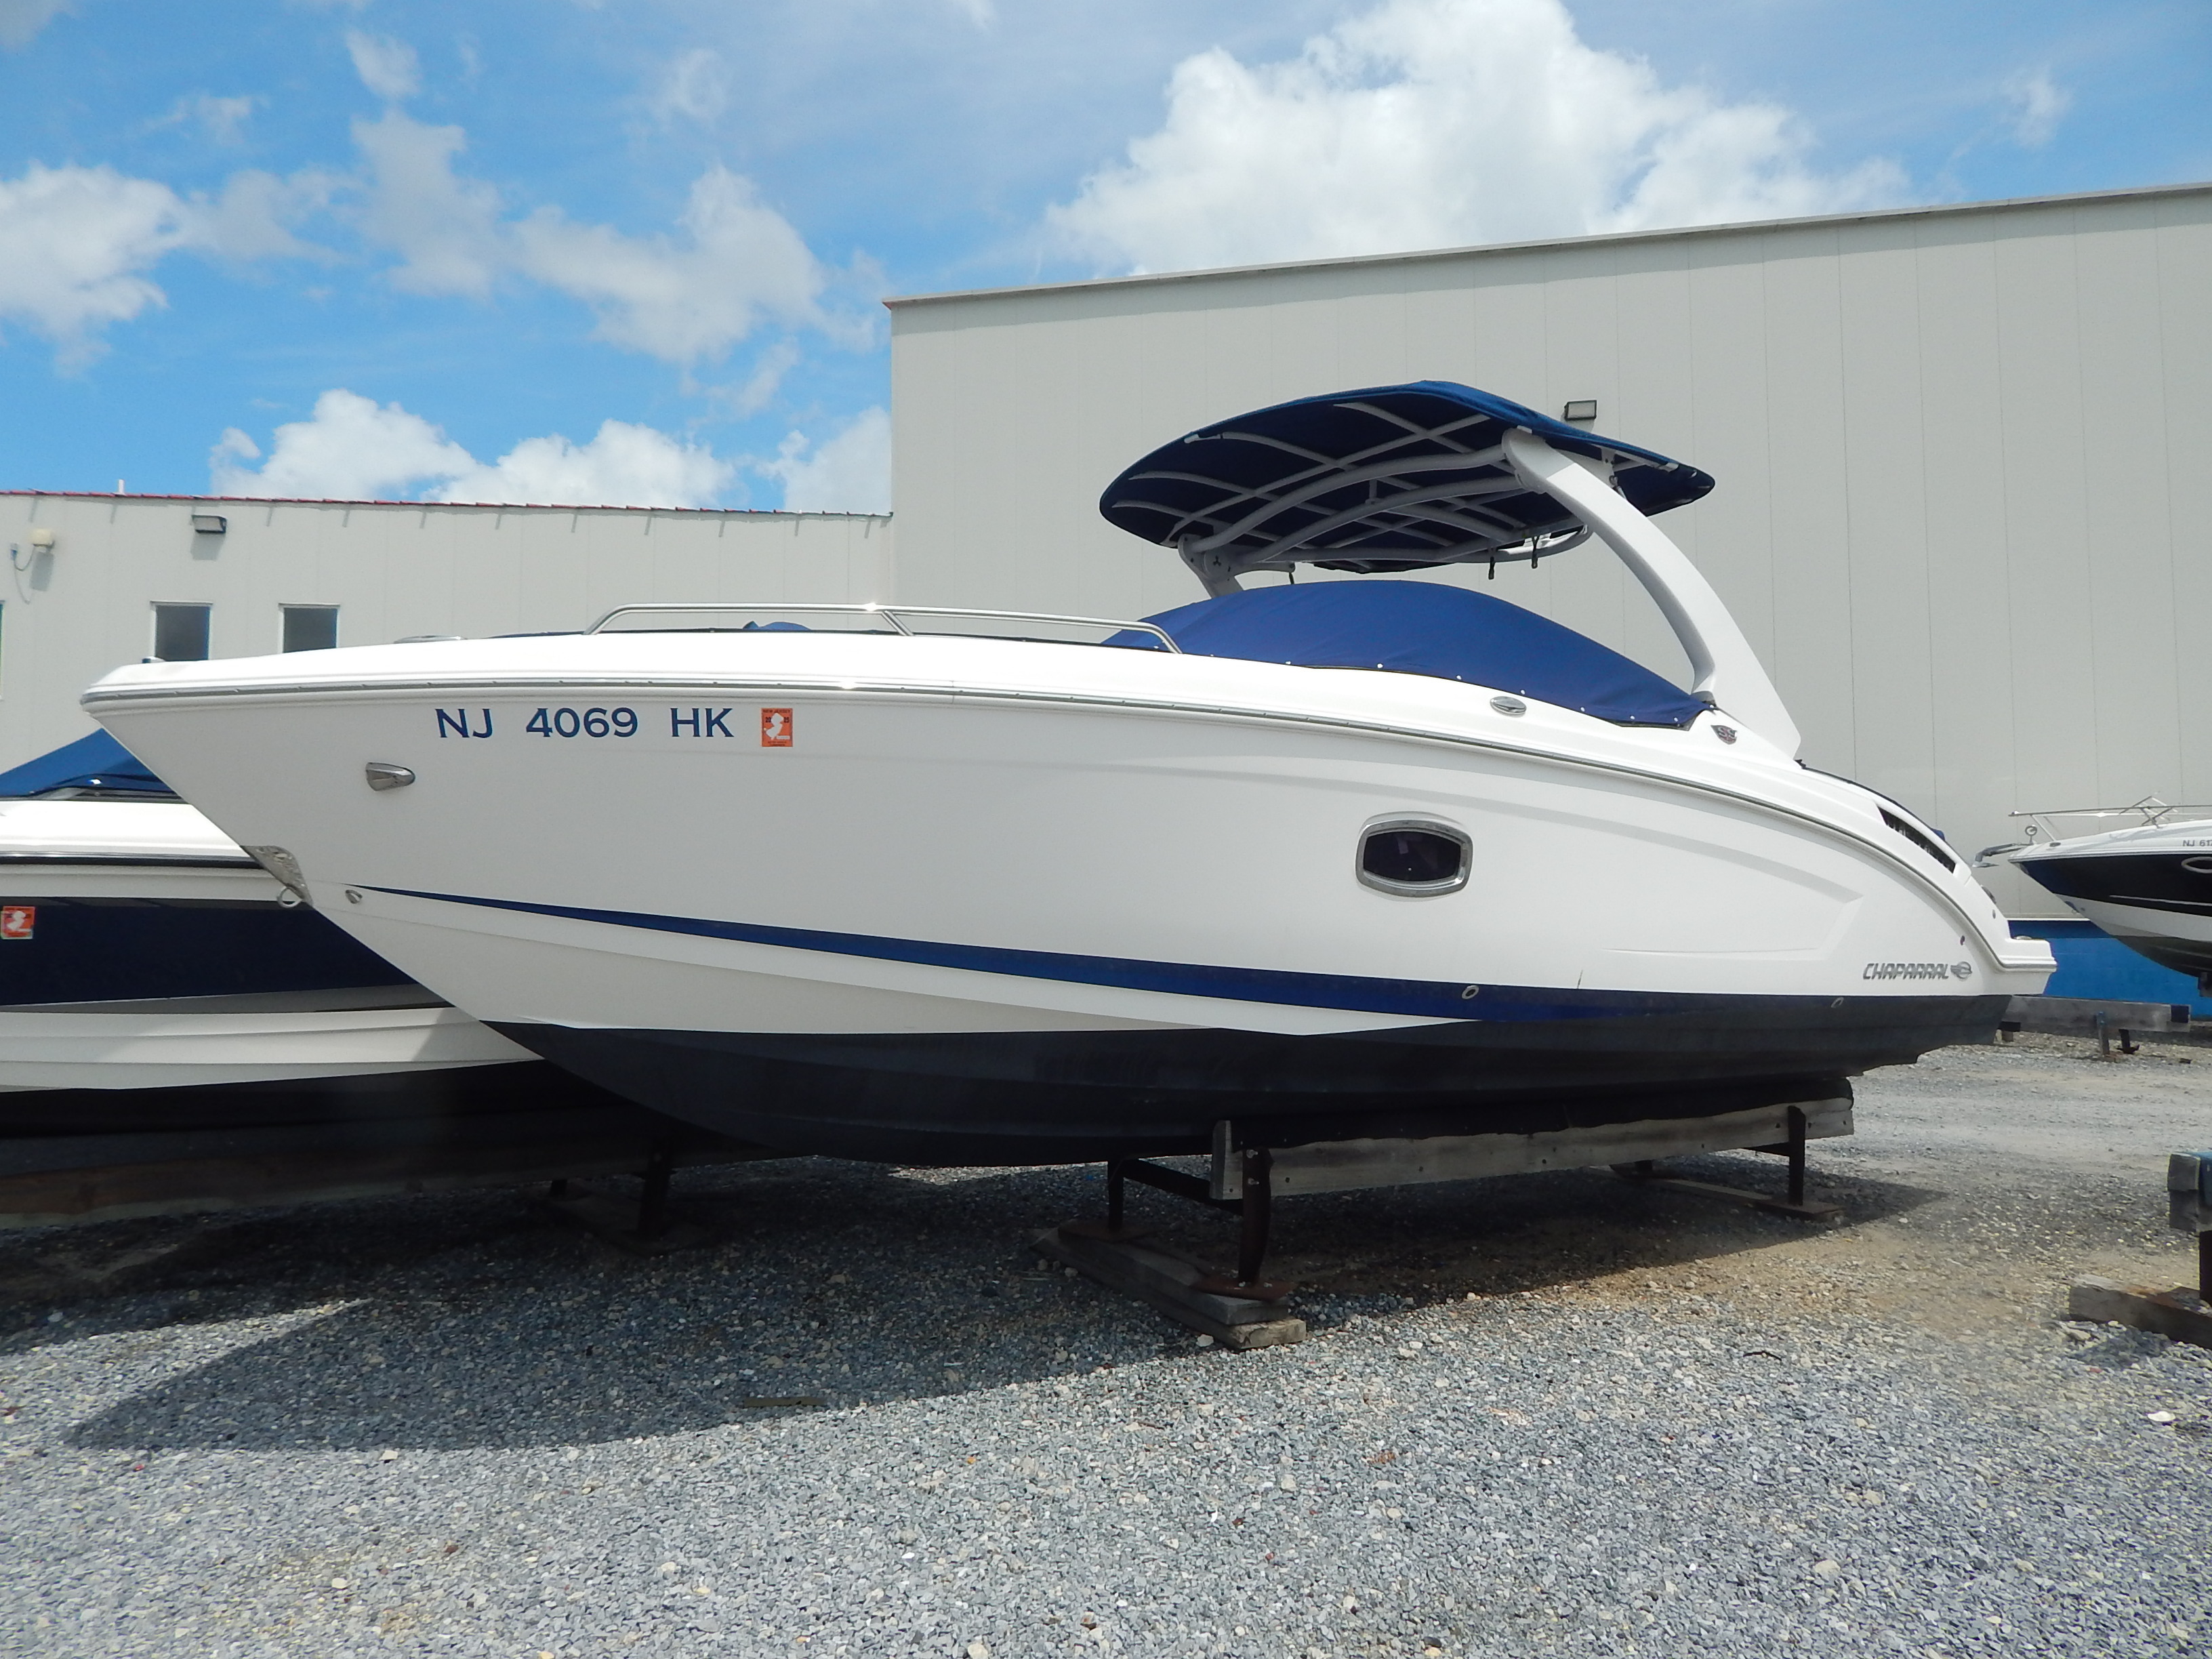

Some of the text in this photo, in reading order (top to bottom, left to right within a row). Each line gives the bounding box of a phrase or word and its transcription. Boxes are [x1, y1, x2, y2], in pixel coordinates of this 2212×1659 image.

[434, 707, 735, 739] NJ 4069 HK
[1863, 962, 1949, 980] CHAPARRAL
